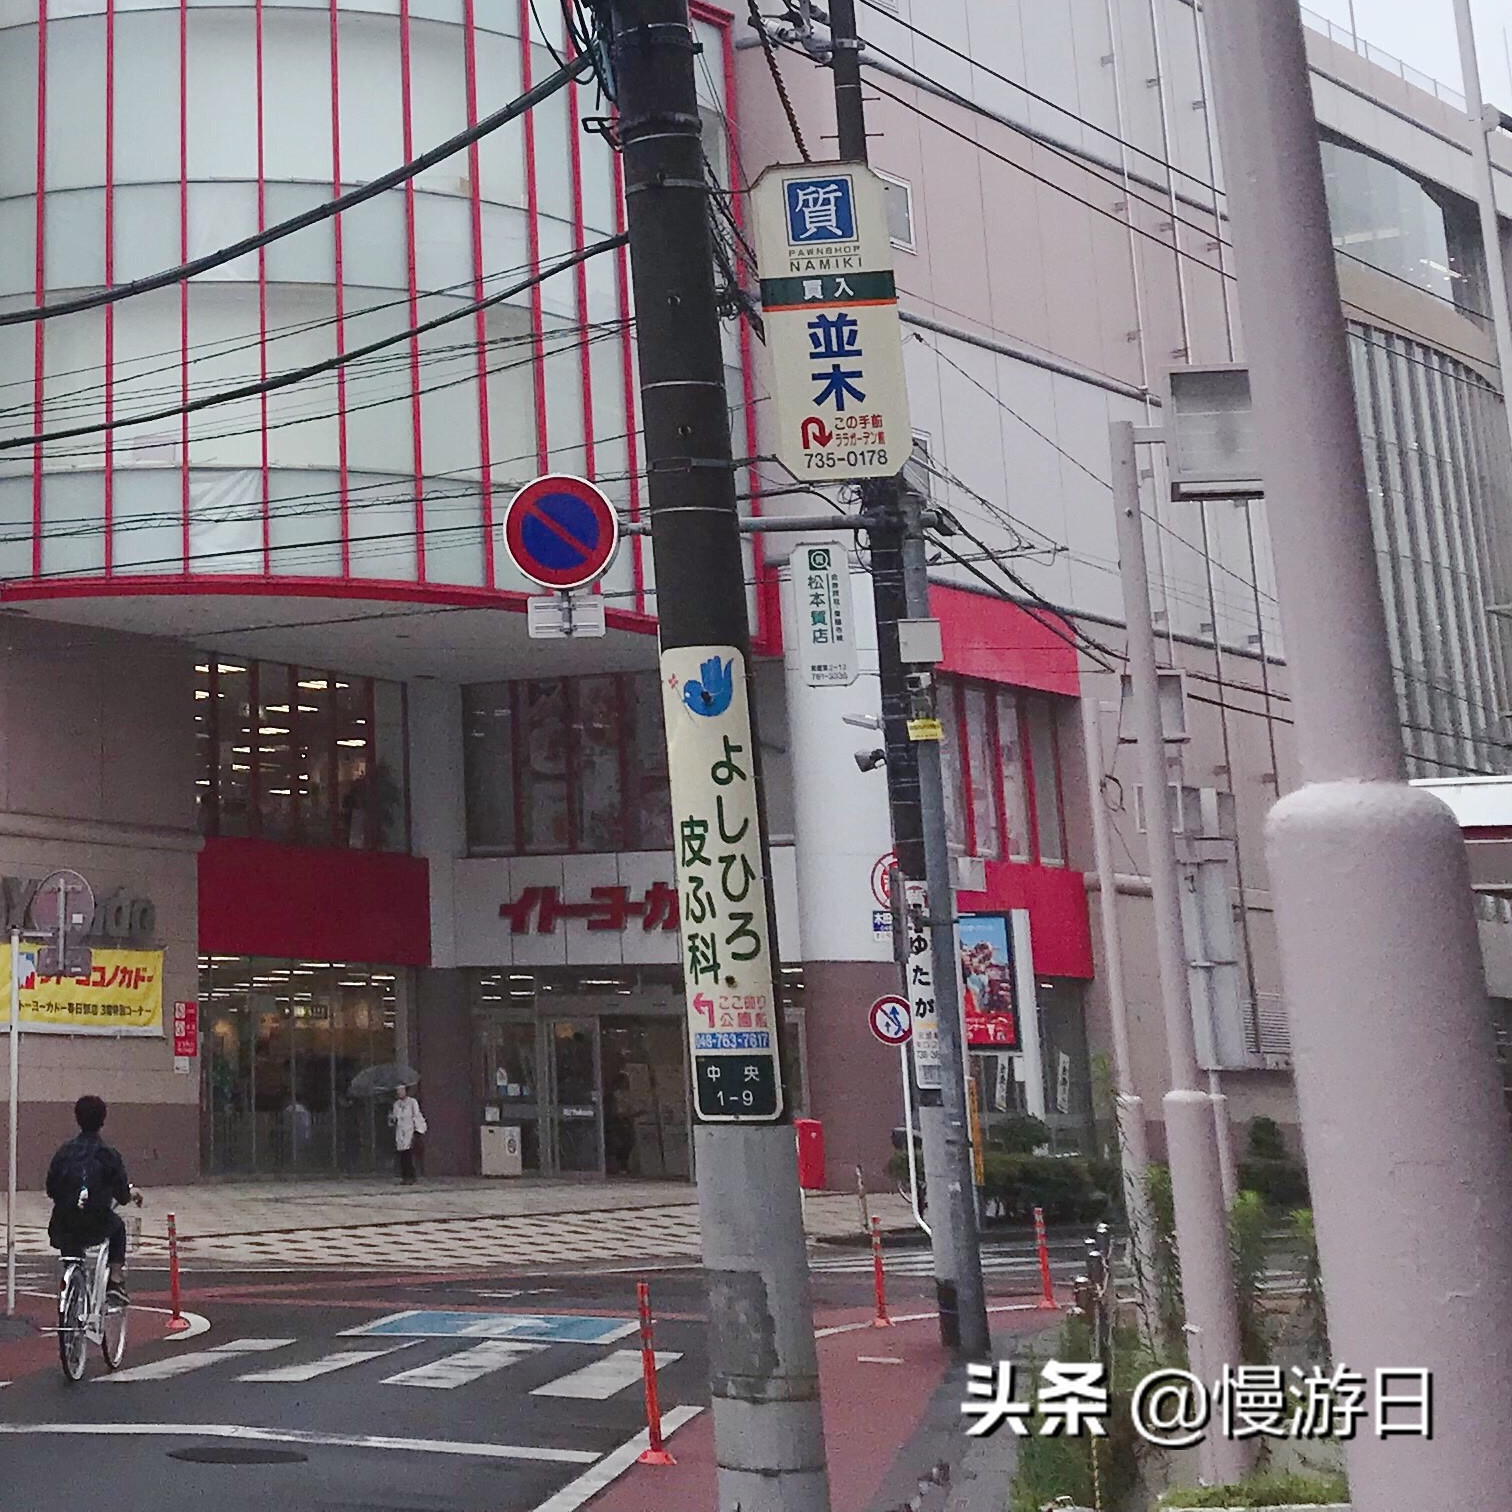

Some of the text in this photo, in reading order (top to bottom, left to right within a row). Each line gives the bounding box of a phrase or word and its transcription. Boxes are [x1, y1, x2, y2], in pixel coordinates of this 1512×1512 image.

[795, 183, 844, 240] 質
[790, 257, 863, 273] NAMIKI
[807, 312, 867, 412] 並木
[803, 448, 889, 470] 735-0178
[711, 734, 762, 962] よしひろ
[680, 814, 721, 987] 皮ふ科
[706, 1065, 760, 1082] 中央
[717, 1089, 754, 1106] 1-9
